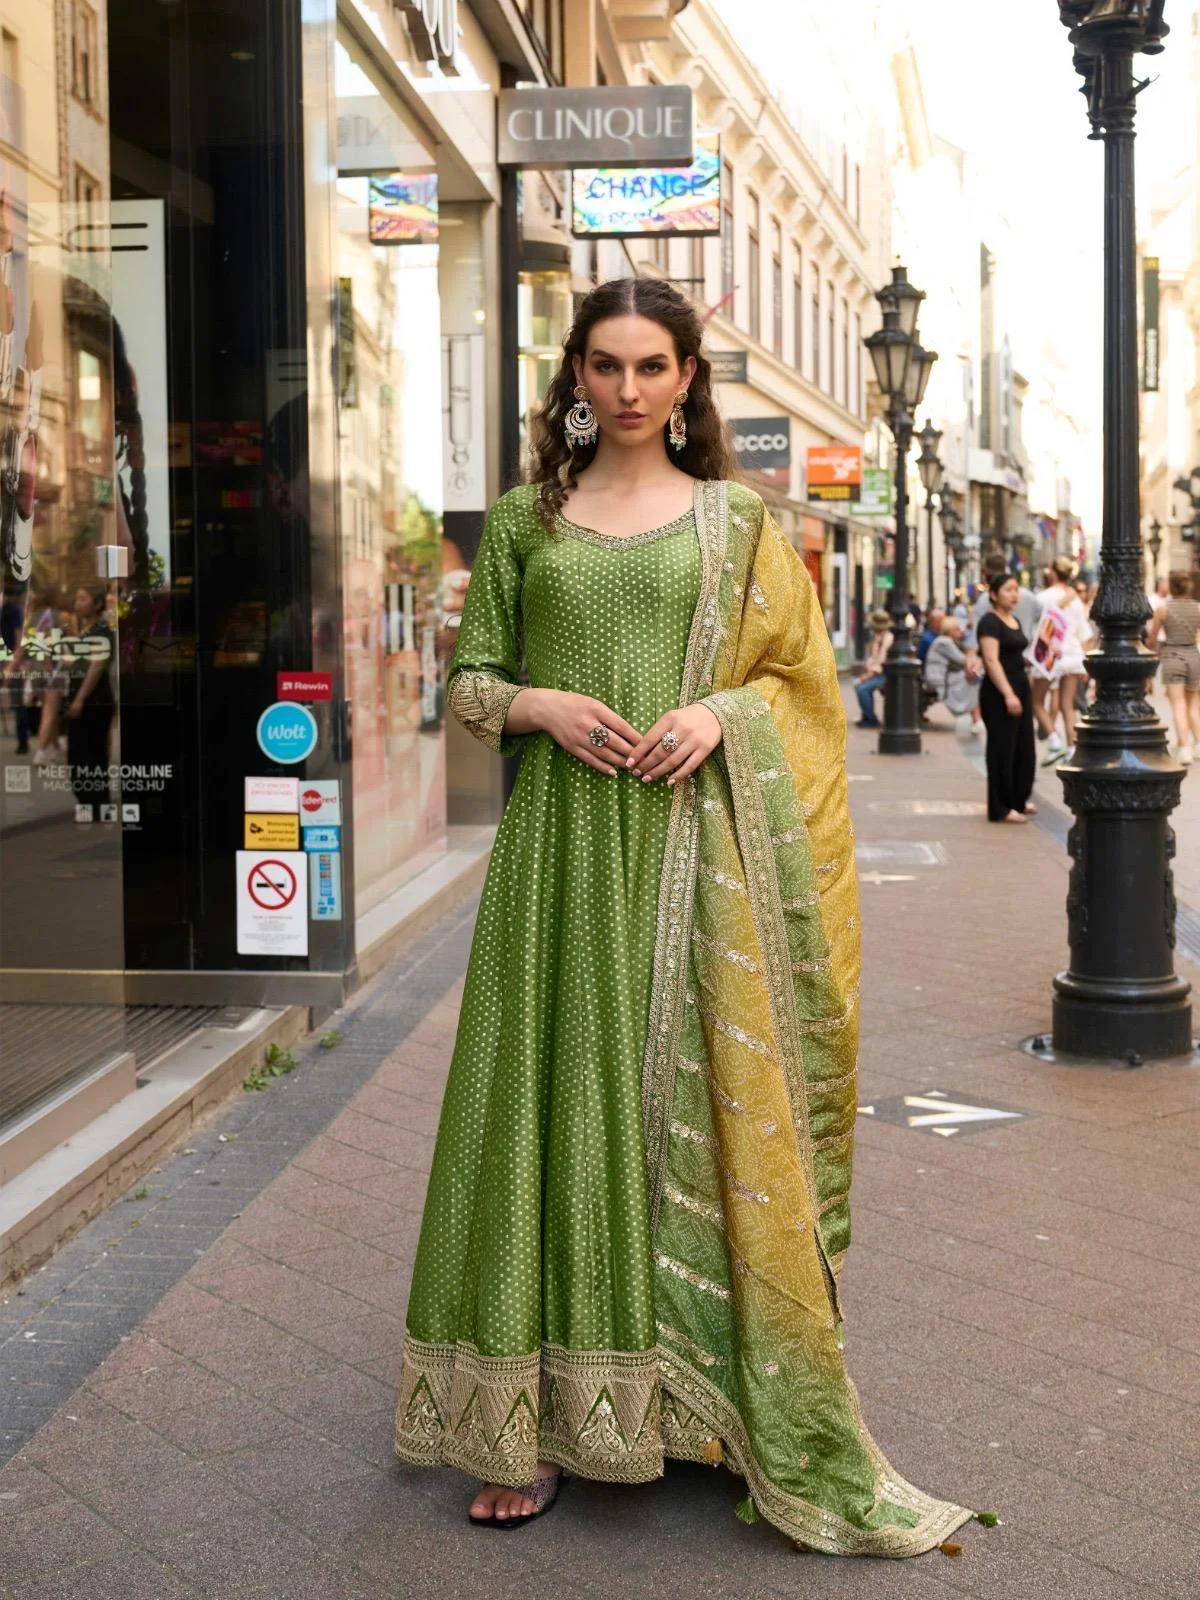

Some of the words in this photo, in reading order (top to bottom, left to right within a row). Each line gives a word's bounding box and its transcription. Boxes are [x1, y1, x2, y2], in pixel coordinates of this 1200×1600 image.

[507, 106, 684, 144] CLINIQUE
[586, 174, 705, 199] CHANGE
[732, 433, 788, 452] ecco
[267, 723, 307, 740] Wolt
[38, 764, 74, 778] MEET
[43, 779, 165, 792] MACCOSMEICS.HU
